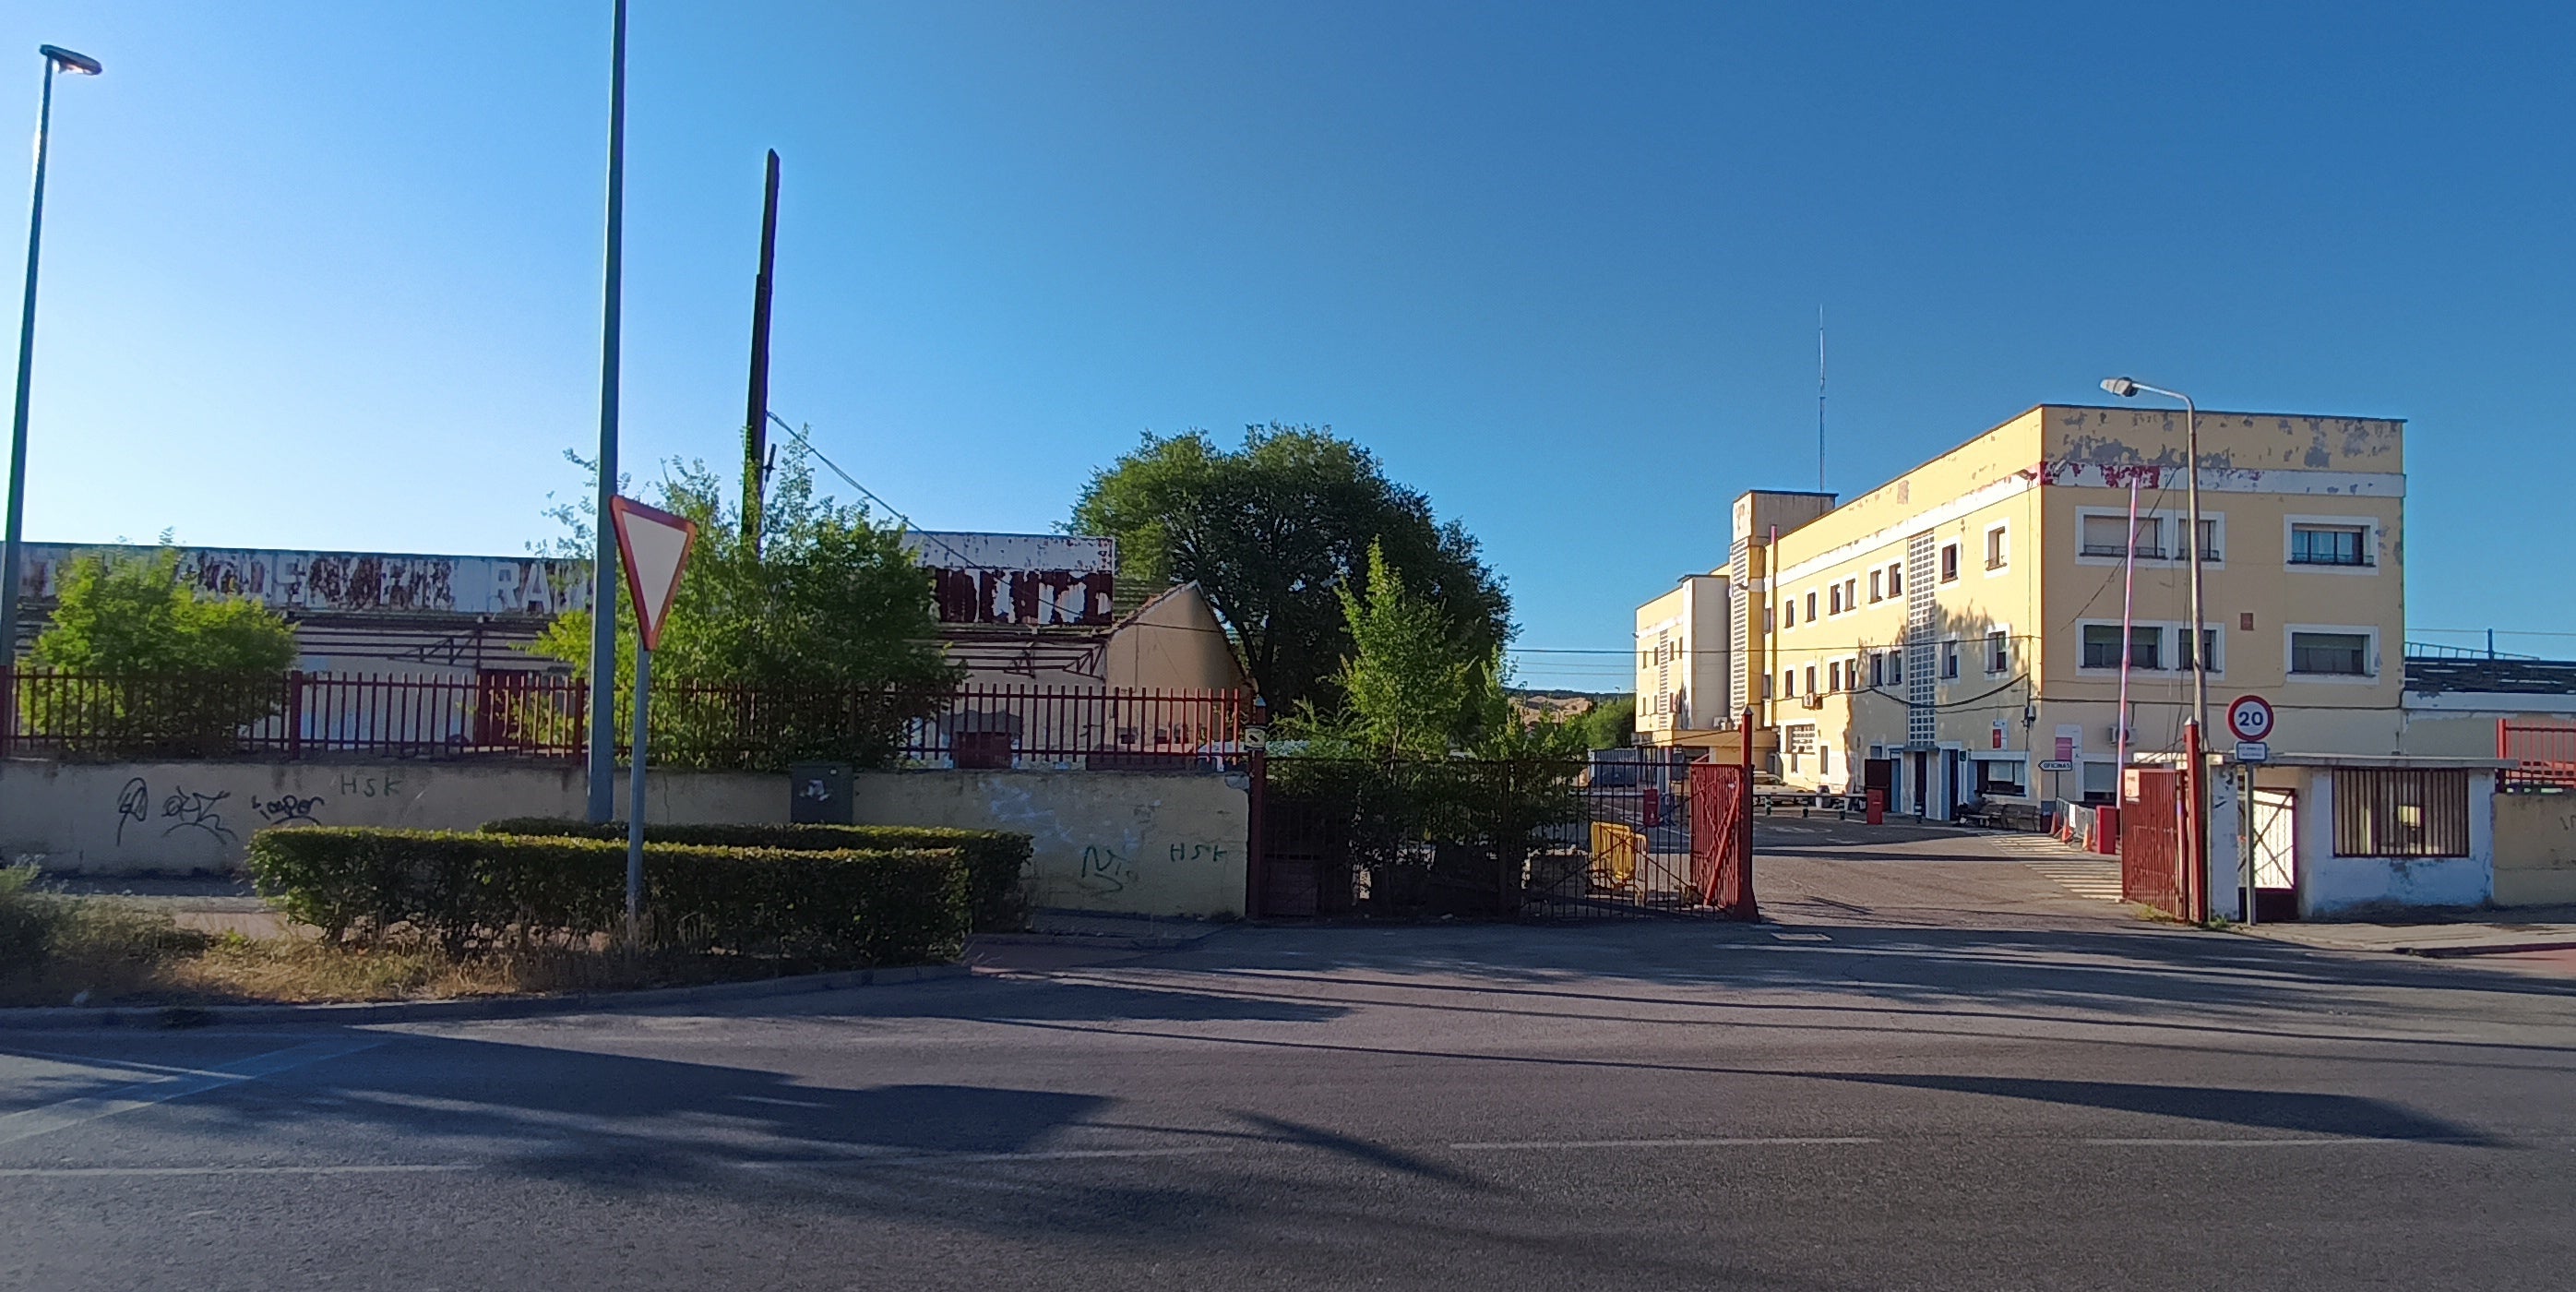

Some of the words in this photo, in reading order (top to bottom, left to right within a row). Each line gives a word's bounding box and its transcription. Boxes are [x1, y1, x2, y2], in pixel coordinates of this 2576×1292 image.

[2238, 711, 2263, 726] 20
[340, 773, 402, 797] HSK
[1170, 843, 1228, 862] HSK
